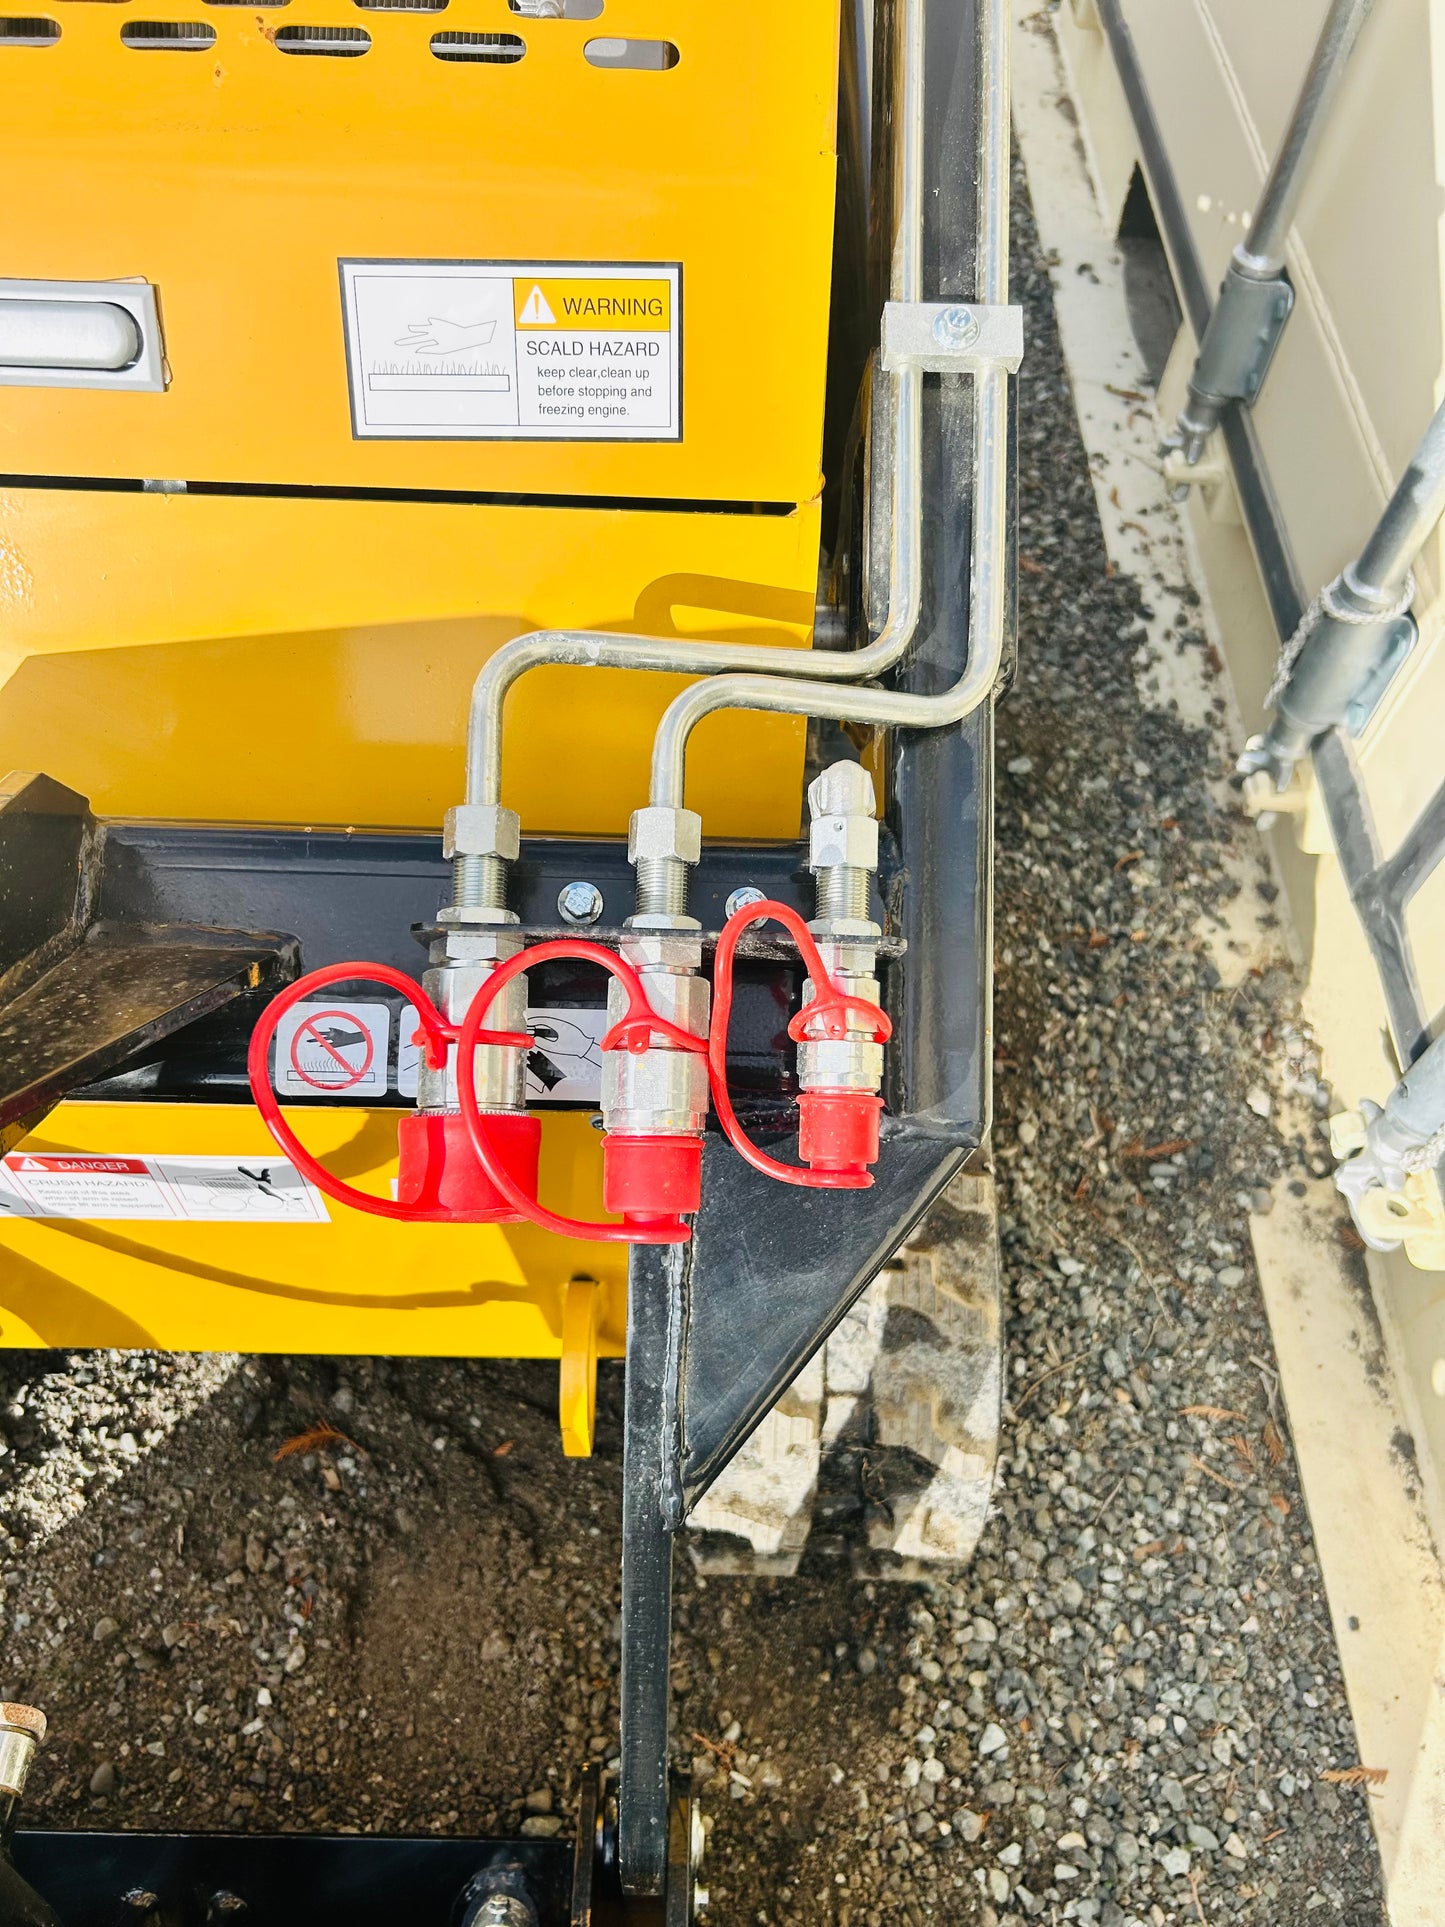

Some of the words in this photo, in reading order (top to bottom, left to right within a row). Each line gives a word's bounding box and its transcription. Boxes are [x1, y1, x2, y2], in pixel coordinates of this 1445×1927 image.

[563, 298, 663, 316] WARNING
[526, 340, 584, 356] SCALD
[589, 341, 660, 357] HAZARD
[537, 366, 566, 380] keep
[635, 369, 650, 381] up
[537, 385, 575, 397] before
[578, 385, 627, 400] stopping
[630, 386, 652, 397] and
[538, 403, 585, 418] freezing
[588, 404, 630, 418] engine.
[57, 1160, 130, 1171] DANGER
[28, 1178, 81, 1186] CRUSH
